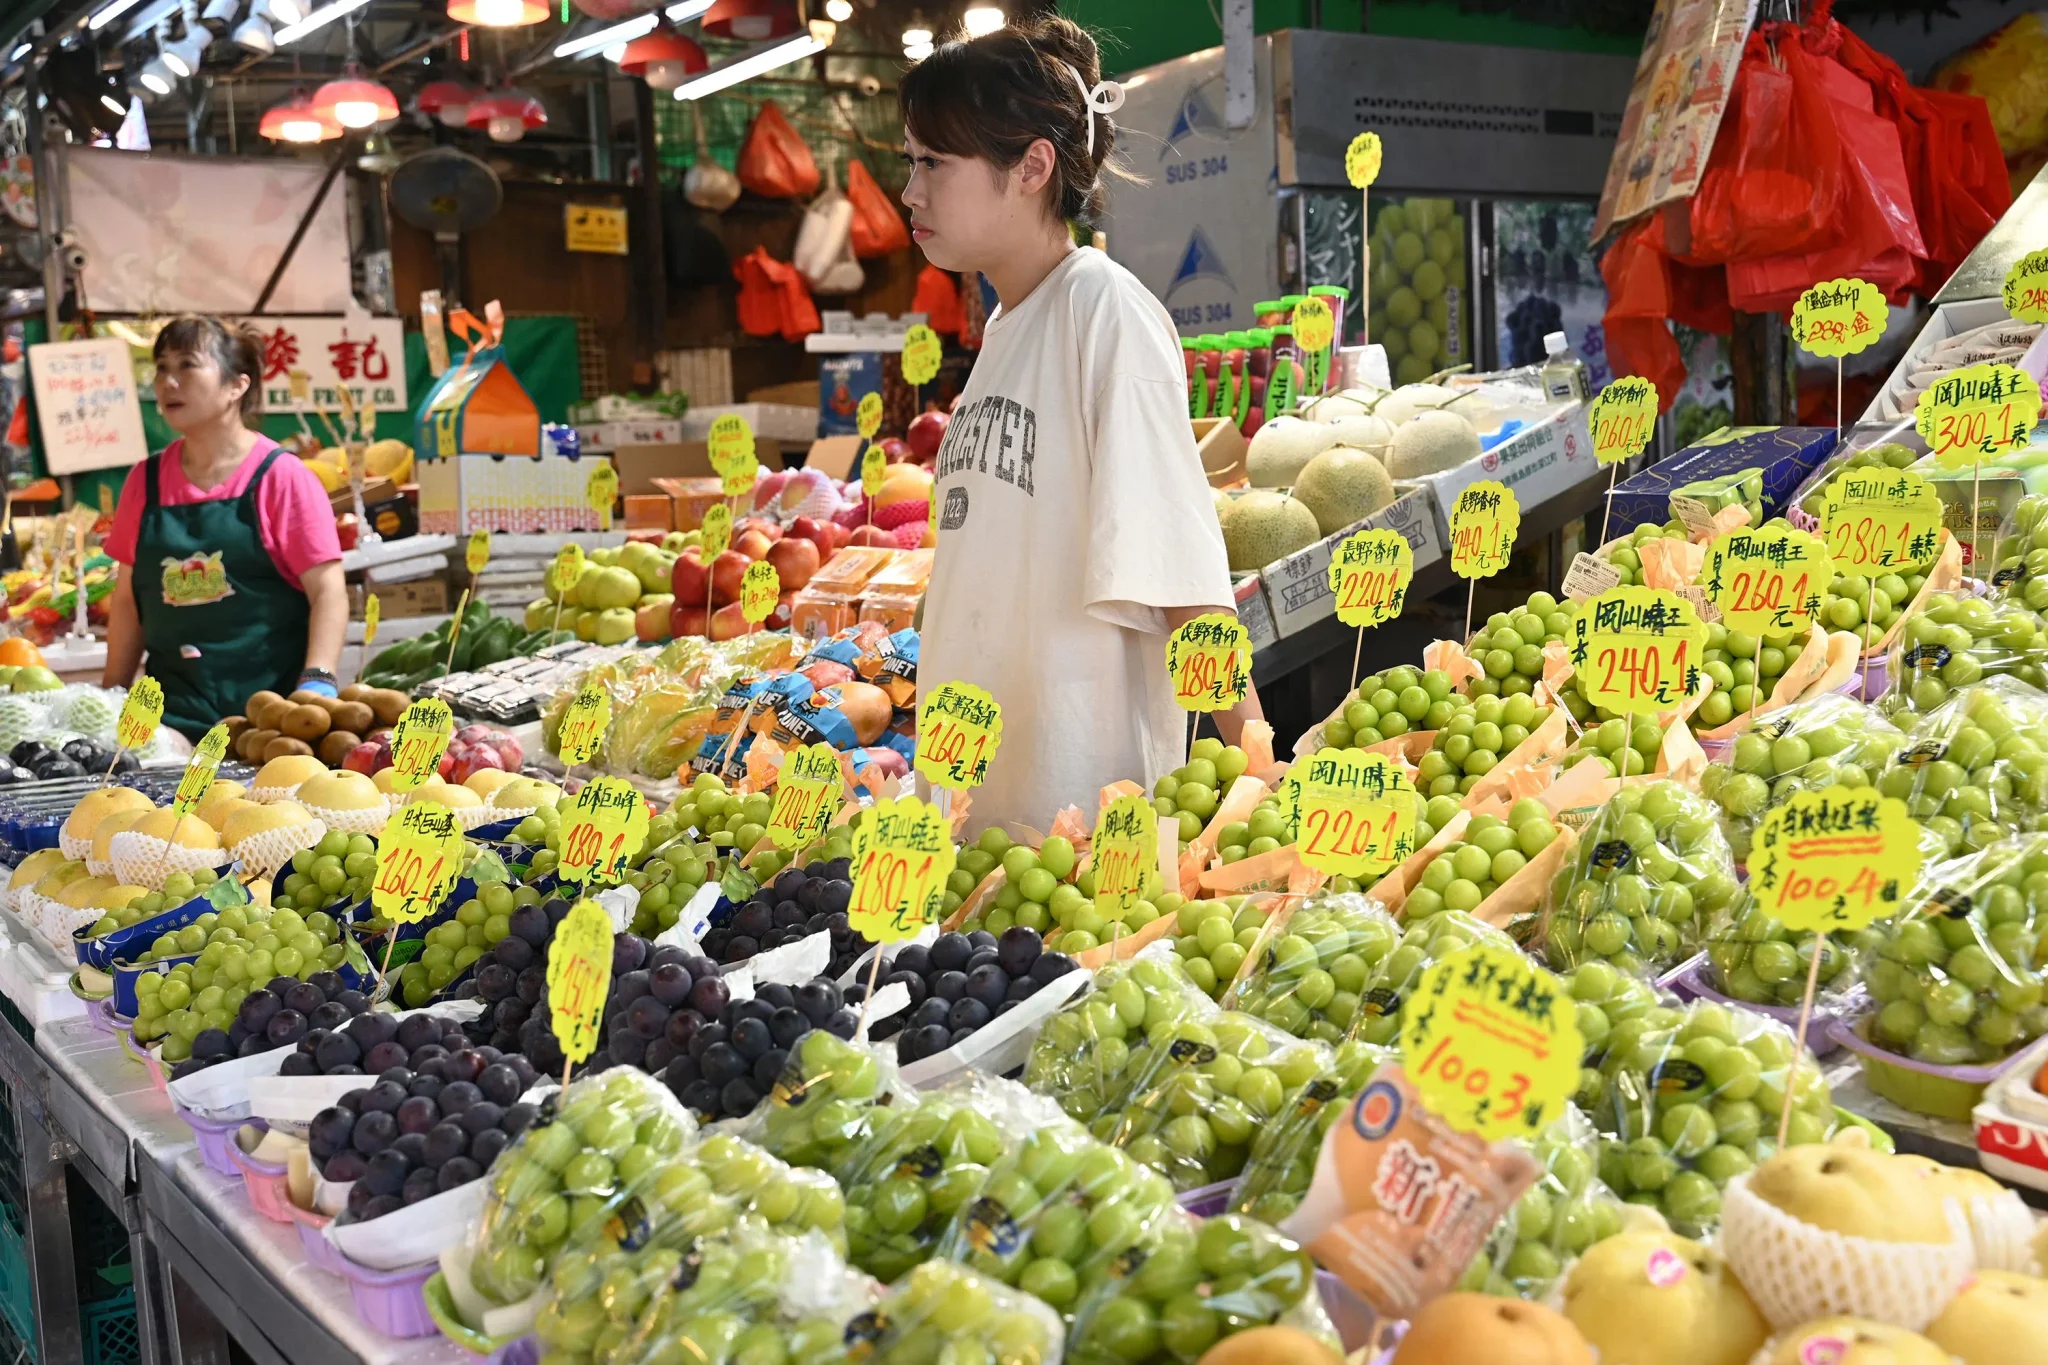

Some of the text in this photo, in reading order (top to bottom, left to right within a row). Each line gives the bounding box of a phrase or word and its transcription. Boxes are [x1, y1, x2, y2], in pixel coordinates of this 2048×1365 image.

[1166, 155, 1228, 184] SUS 304
[1173, 302, 1232, 326] SUS 304
[1934, 370, 2027, 407] 岡山晴王
[1342, 539, 1400, 566] 長野香印
[1727, 536, 1807, 569] 岡山晴王
[1181, 621, 1238, 647] 長野香印
[1594, 598, 1690, 636] 岡山晴王
[1571, 618, 1588, 667] 日本
[1309, 760, 1411, 801] 岡山晴王
[577, 783, 637, 823] 日本巨峰
